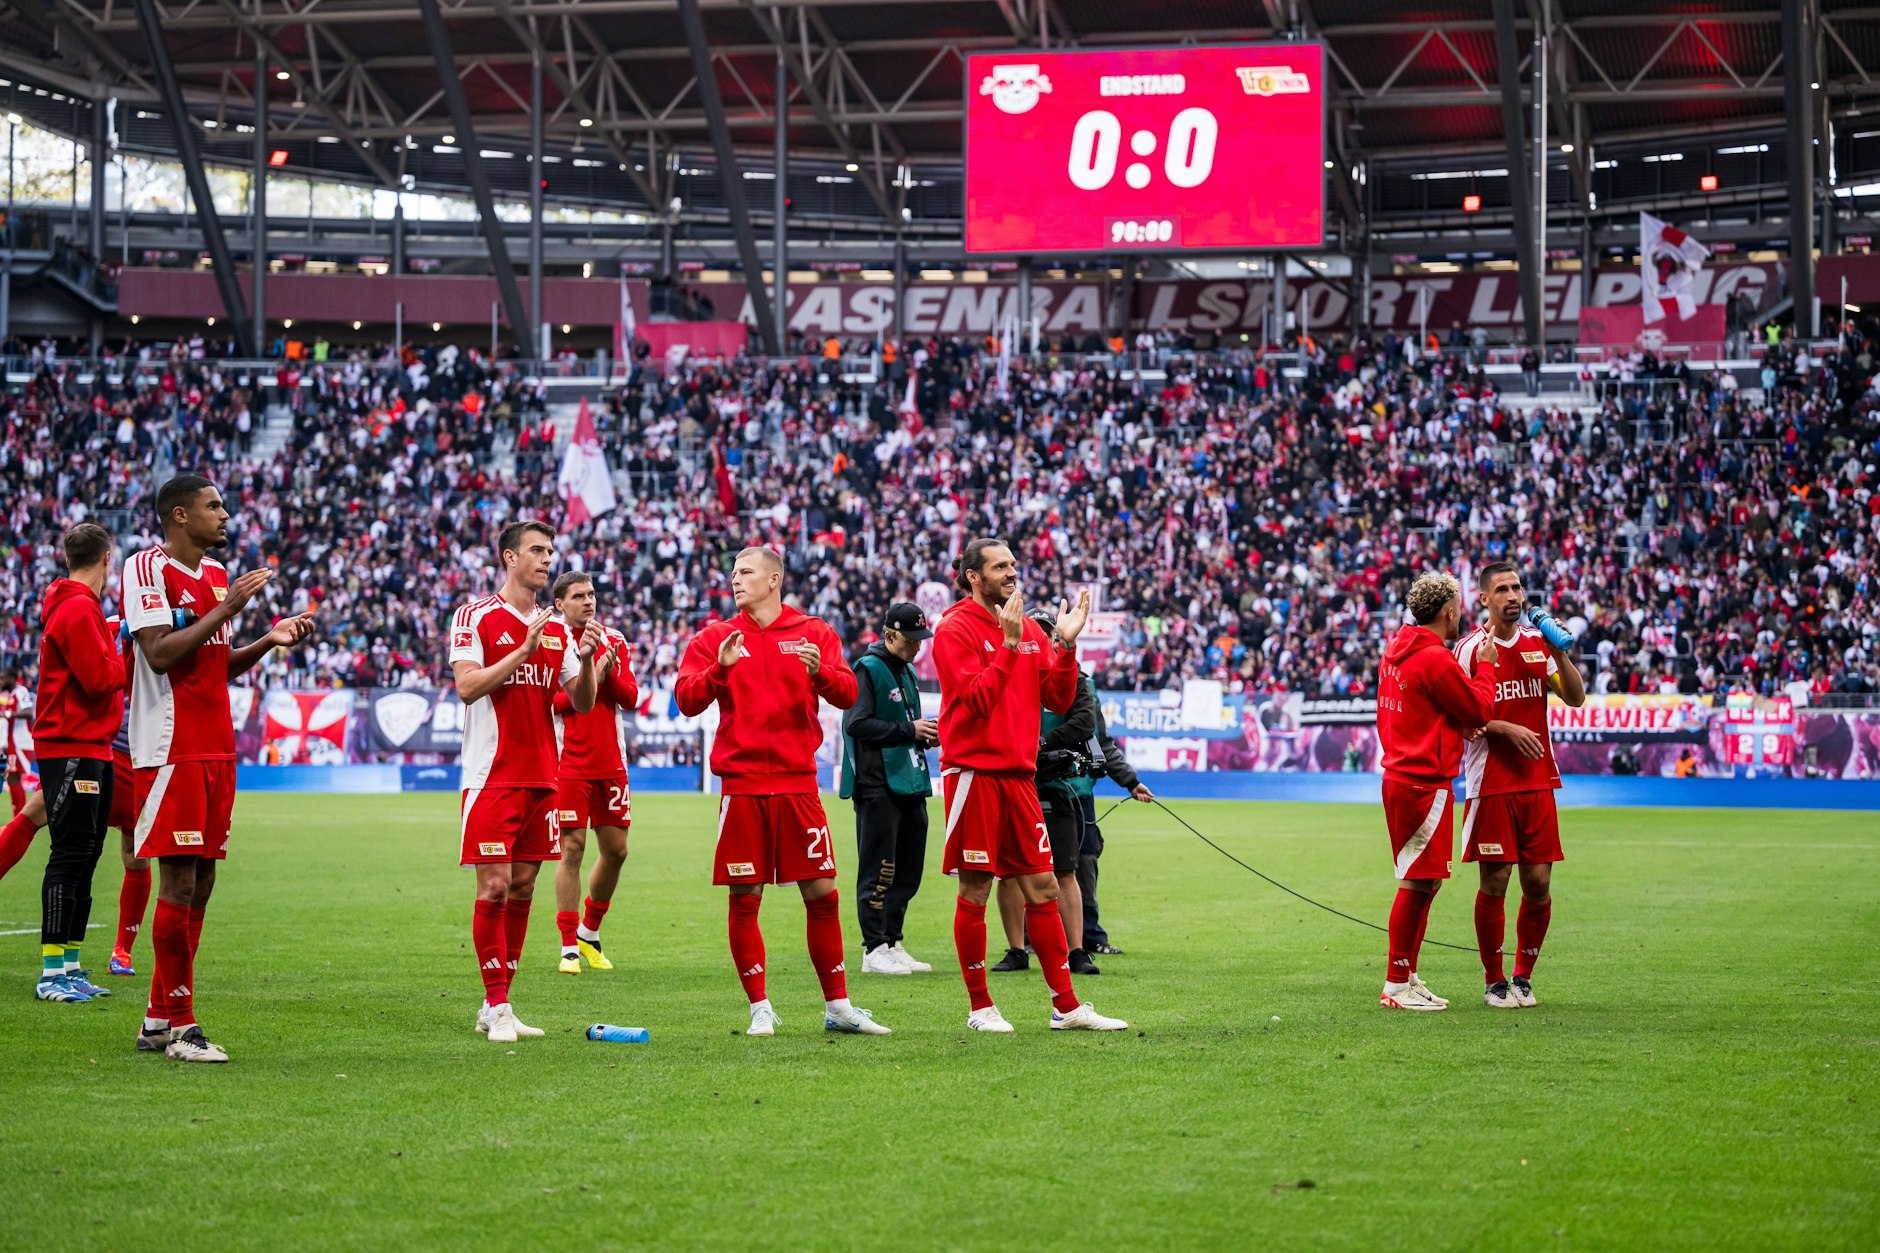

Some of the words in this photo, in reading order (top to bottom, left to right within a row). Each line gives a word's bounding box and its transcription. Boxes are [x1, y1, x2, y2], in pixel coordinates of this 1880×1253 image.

[1100, 74, 1186, 96] ENDSTAND
[1068, 107, 1218, 191] 0:0
[1111, 220, 1173, 243] 90:00
[1468, 266, 1768, 324] LEIPIG
[1494, 677, 1543, 702] BERLIN
[1126, 708, 1196, 732] DELITZS
[1549, 705, 1676, 732] NNEWITZ
[608, 784, 631, 811] 24
[545, 808, 561, 841] 19
[1036, 822, 1051, 853] 2
[807, 825, 831, 858] 21
[868, 859, 896, 910] JORN
